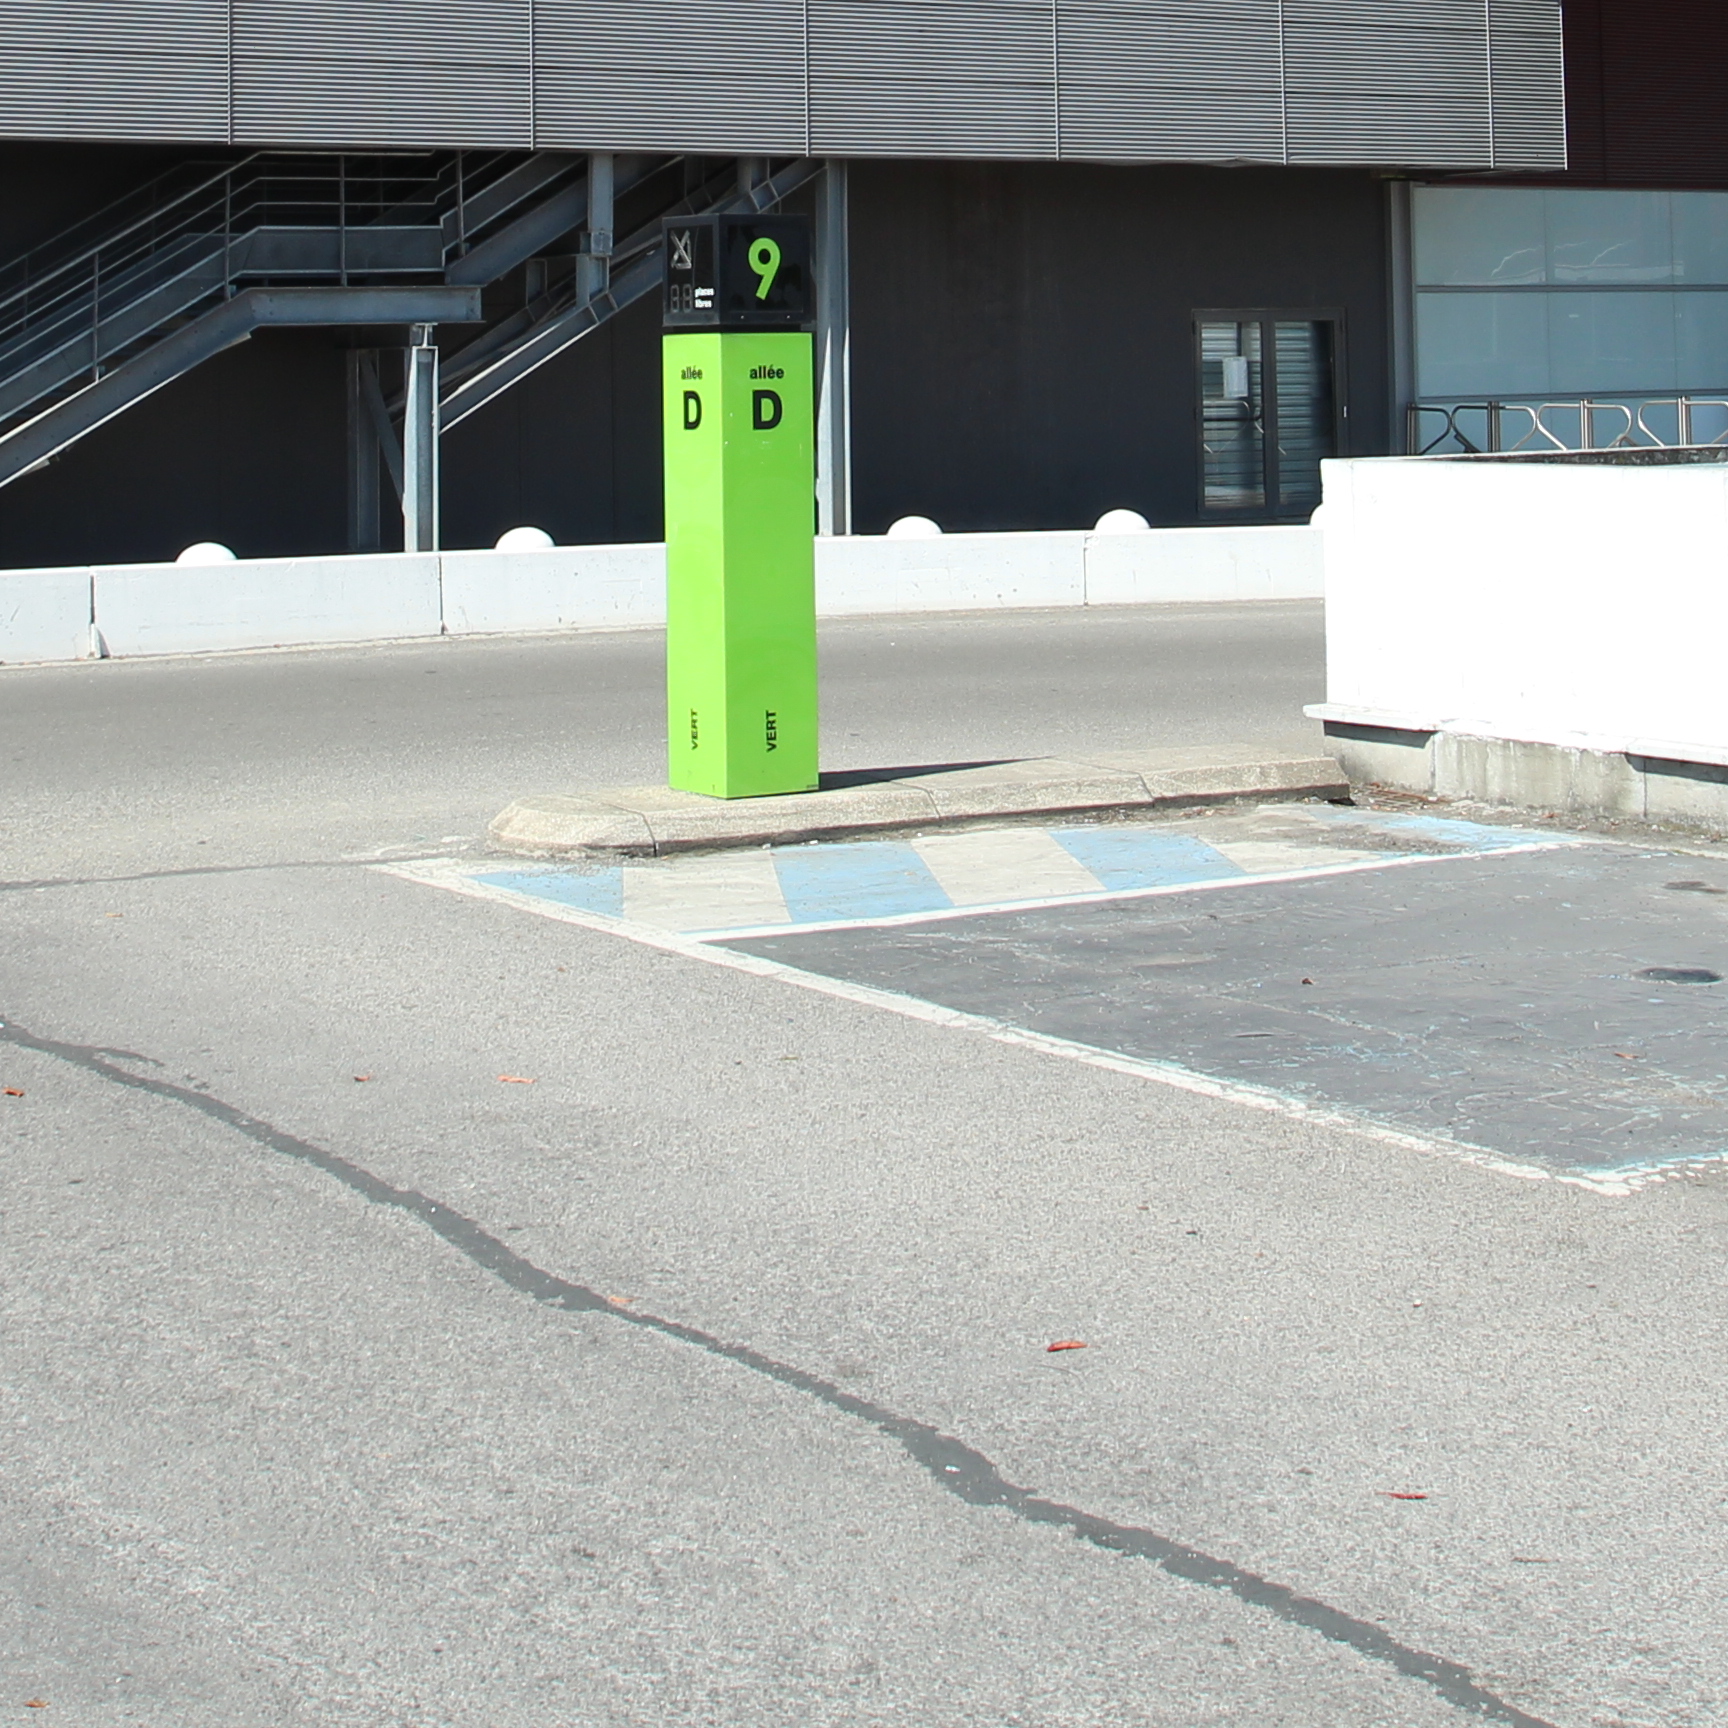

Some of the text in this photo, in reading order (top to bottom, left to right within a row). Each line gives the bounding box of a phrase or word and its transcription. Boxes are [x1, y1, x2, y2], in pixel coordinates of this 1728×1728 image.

[748, 237, 781, 301] 9
[681, 365, 703, 380] allée
[749, 364, 785, 380] allée
[683, 390, 703, 431] D
[752, 389, 783, 431] D
[690, 708, 699, 751] VERT
[765, 709, 777, 753] VERT
